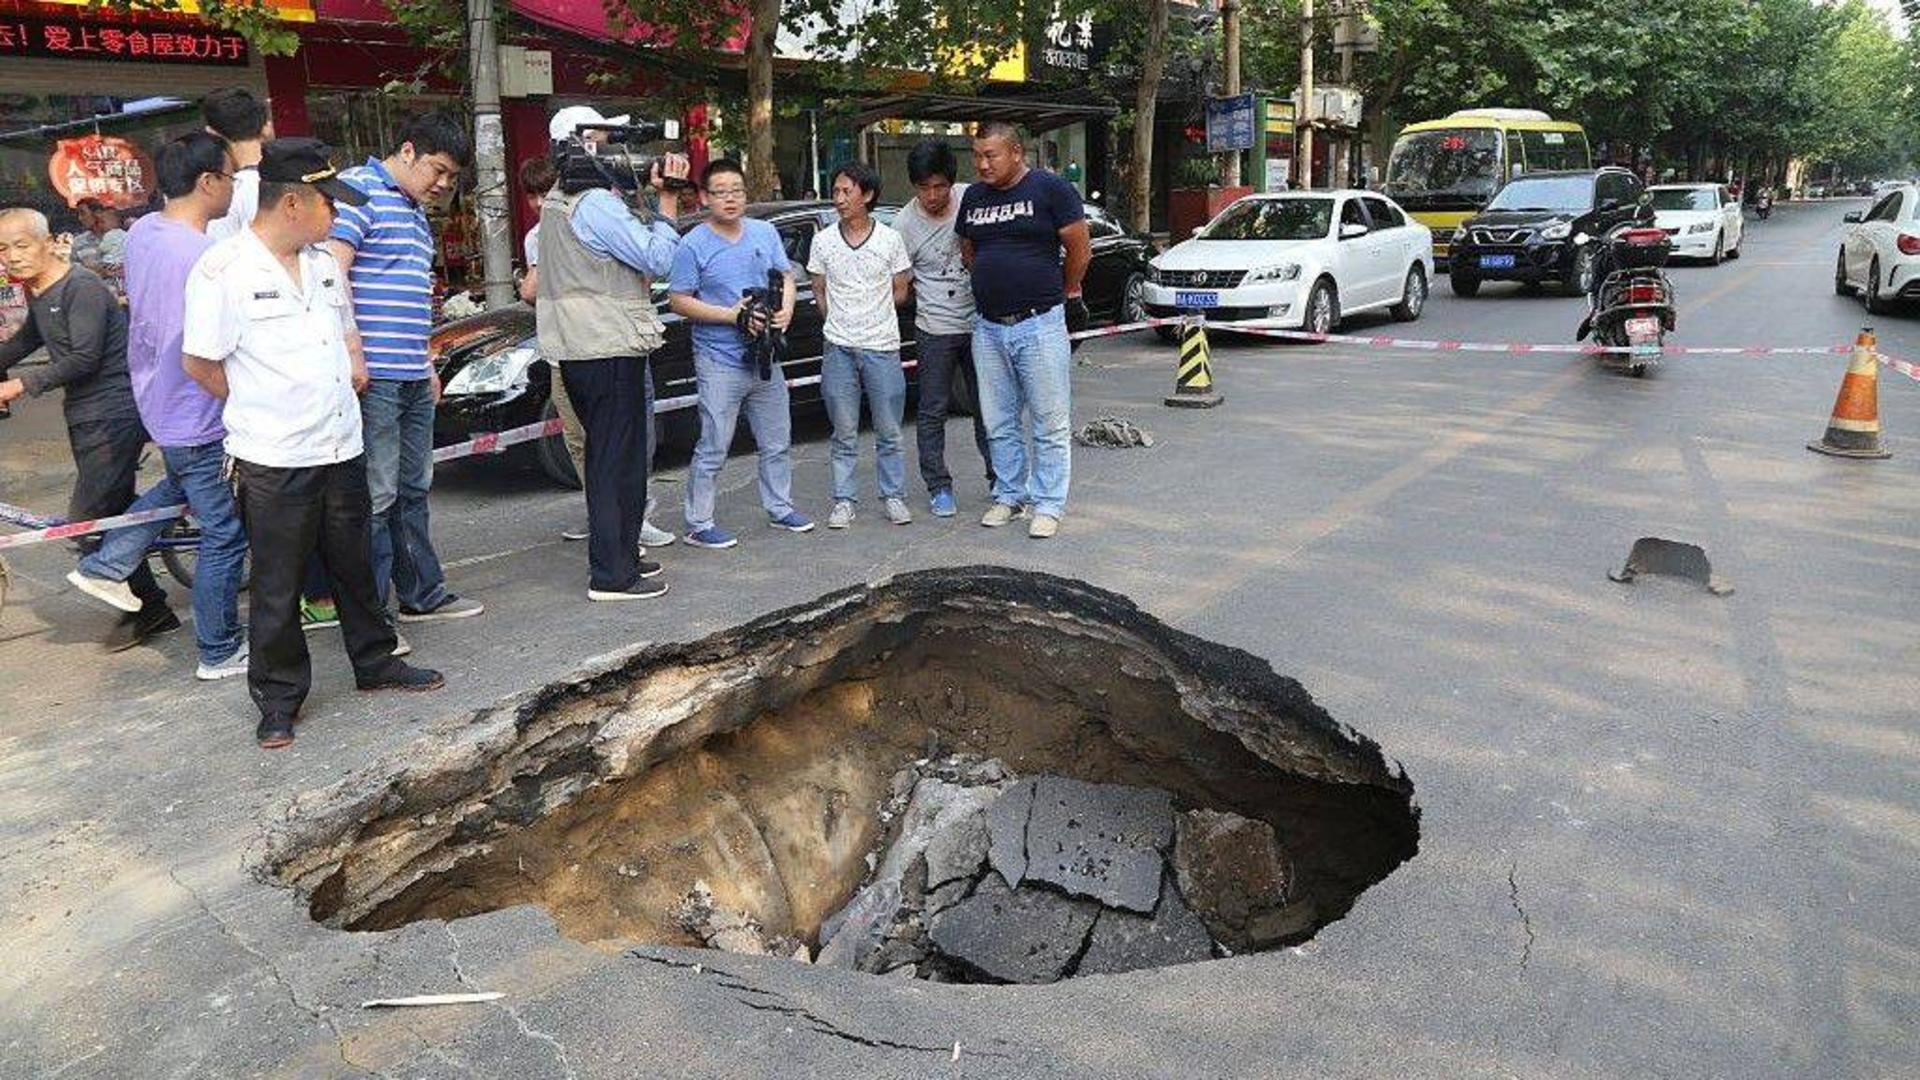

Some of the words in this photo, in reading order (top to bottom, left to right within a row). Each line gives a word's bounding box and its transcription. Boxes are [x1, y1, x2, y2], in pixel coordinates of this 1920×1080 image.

[44, 25, 242, 57] 爱上零食屋致力于
